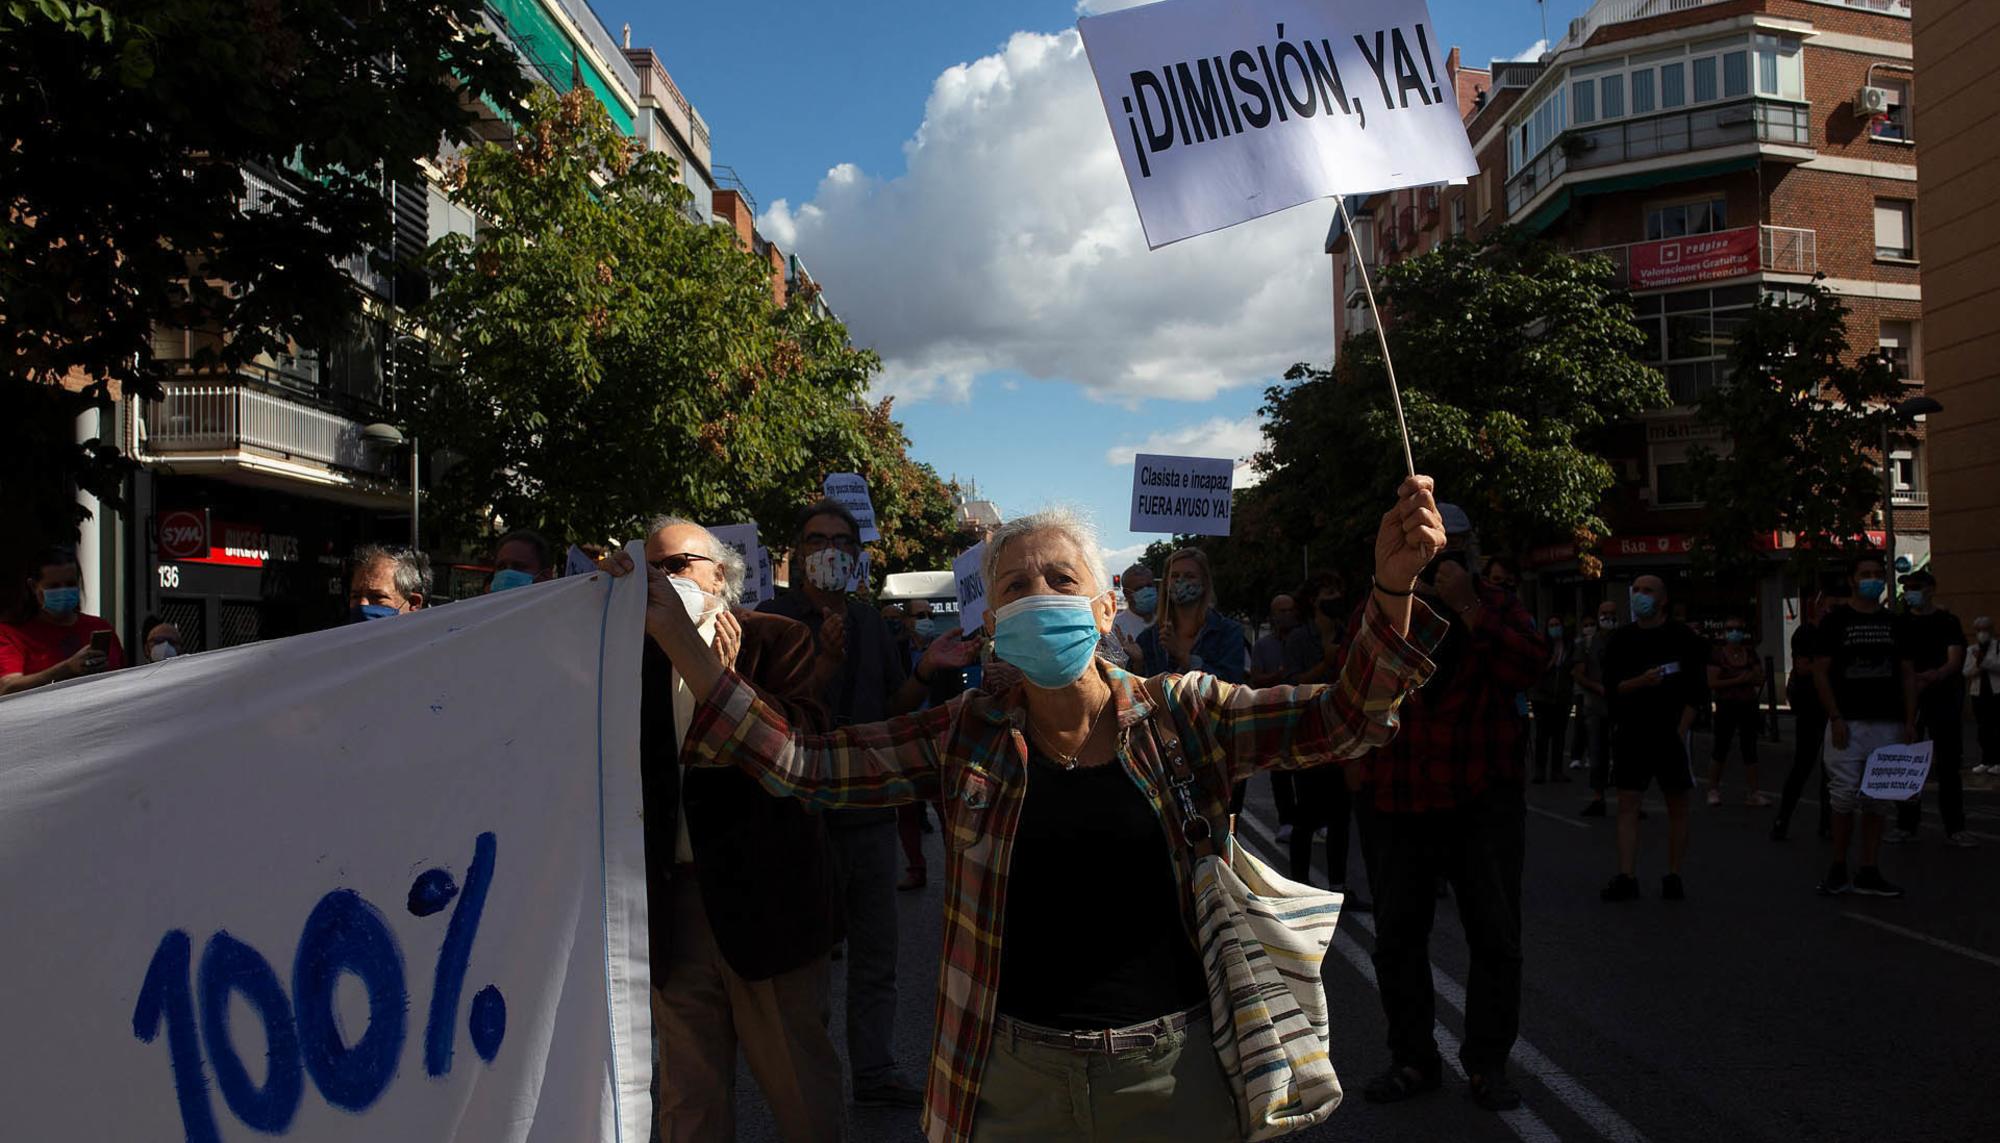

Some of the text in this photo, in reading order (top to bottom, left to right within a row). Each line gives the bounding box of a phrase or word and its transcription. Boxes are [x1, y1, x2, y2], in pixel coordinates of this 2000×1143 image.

[1122, 23, 1443, 178] ¡DIMISIÓN, YA!
[1640, 254, 1749, 278] Valoraciones Gratuitas
[1699, 265, 1749, 281] Herencias
[1141, 466, 1230, 494] Clasista e incapaz,
[1138, 495, 1229, 519] FUERA AYUSO YA!
[162, 527, 201, 545] SYM
[158, 565, 180, 588] 136
[134, 831, 507, 1143] 100%
